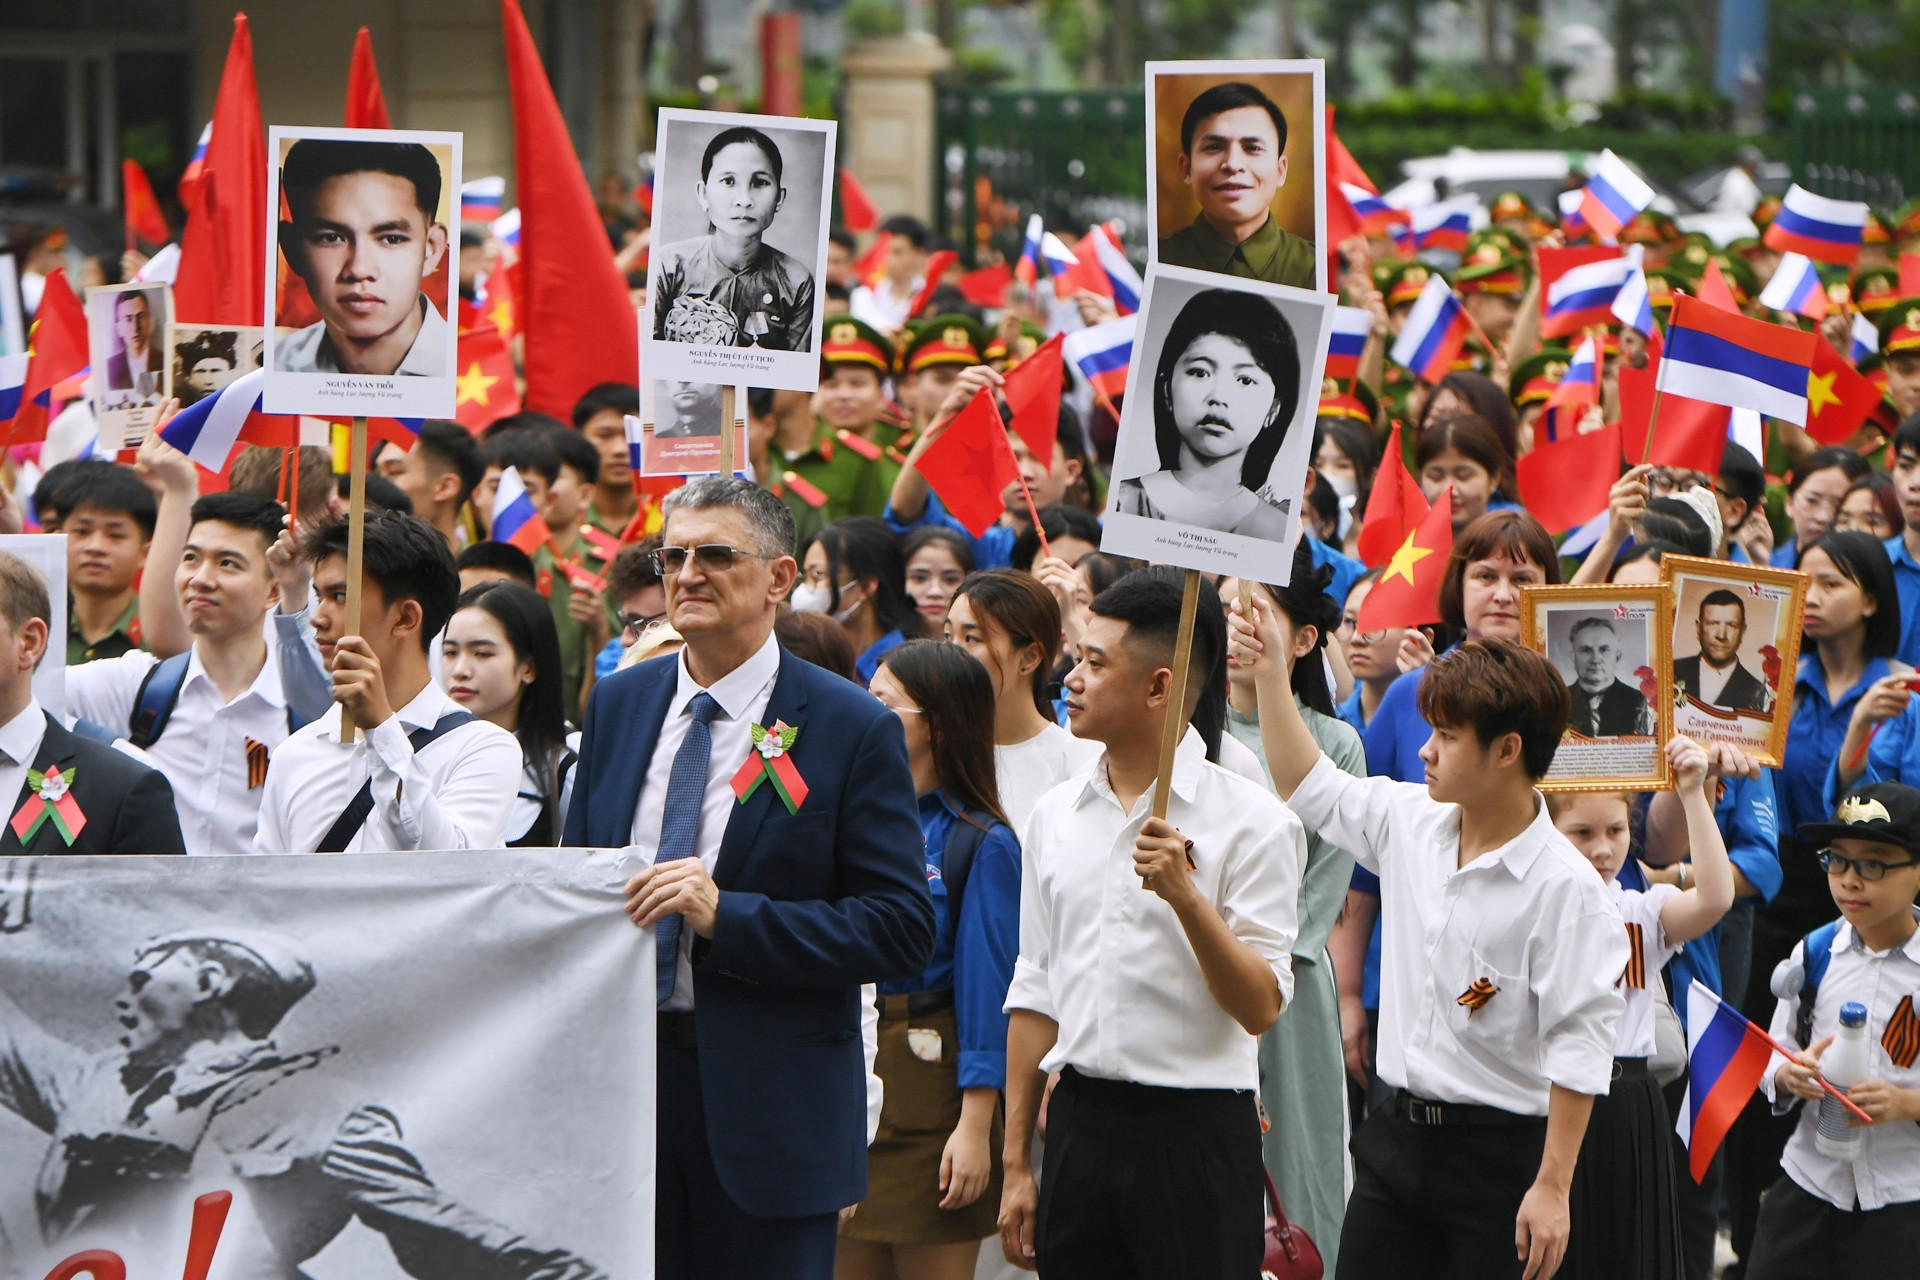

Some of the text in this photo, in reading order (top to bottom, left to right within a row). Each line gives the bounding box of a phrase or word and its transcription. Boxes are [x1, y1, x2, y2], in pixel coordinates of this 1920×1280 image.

[719, 352, 731, 360] THỊ
[1190, 533, 1203, 543] THỊ
[1222, 550, 1239, 558] trang
[1688, 715, 1743, 733] Савченков
[1703, 730, 1766, 748] Гаврилович
